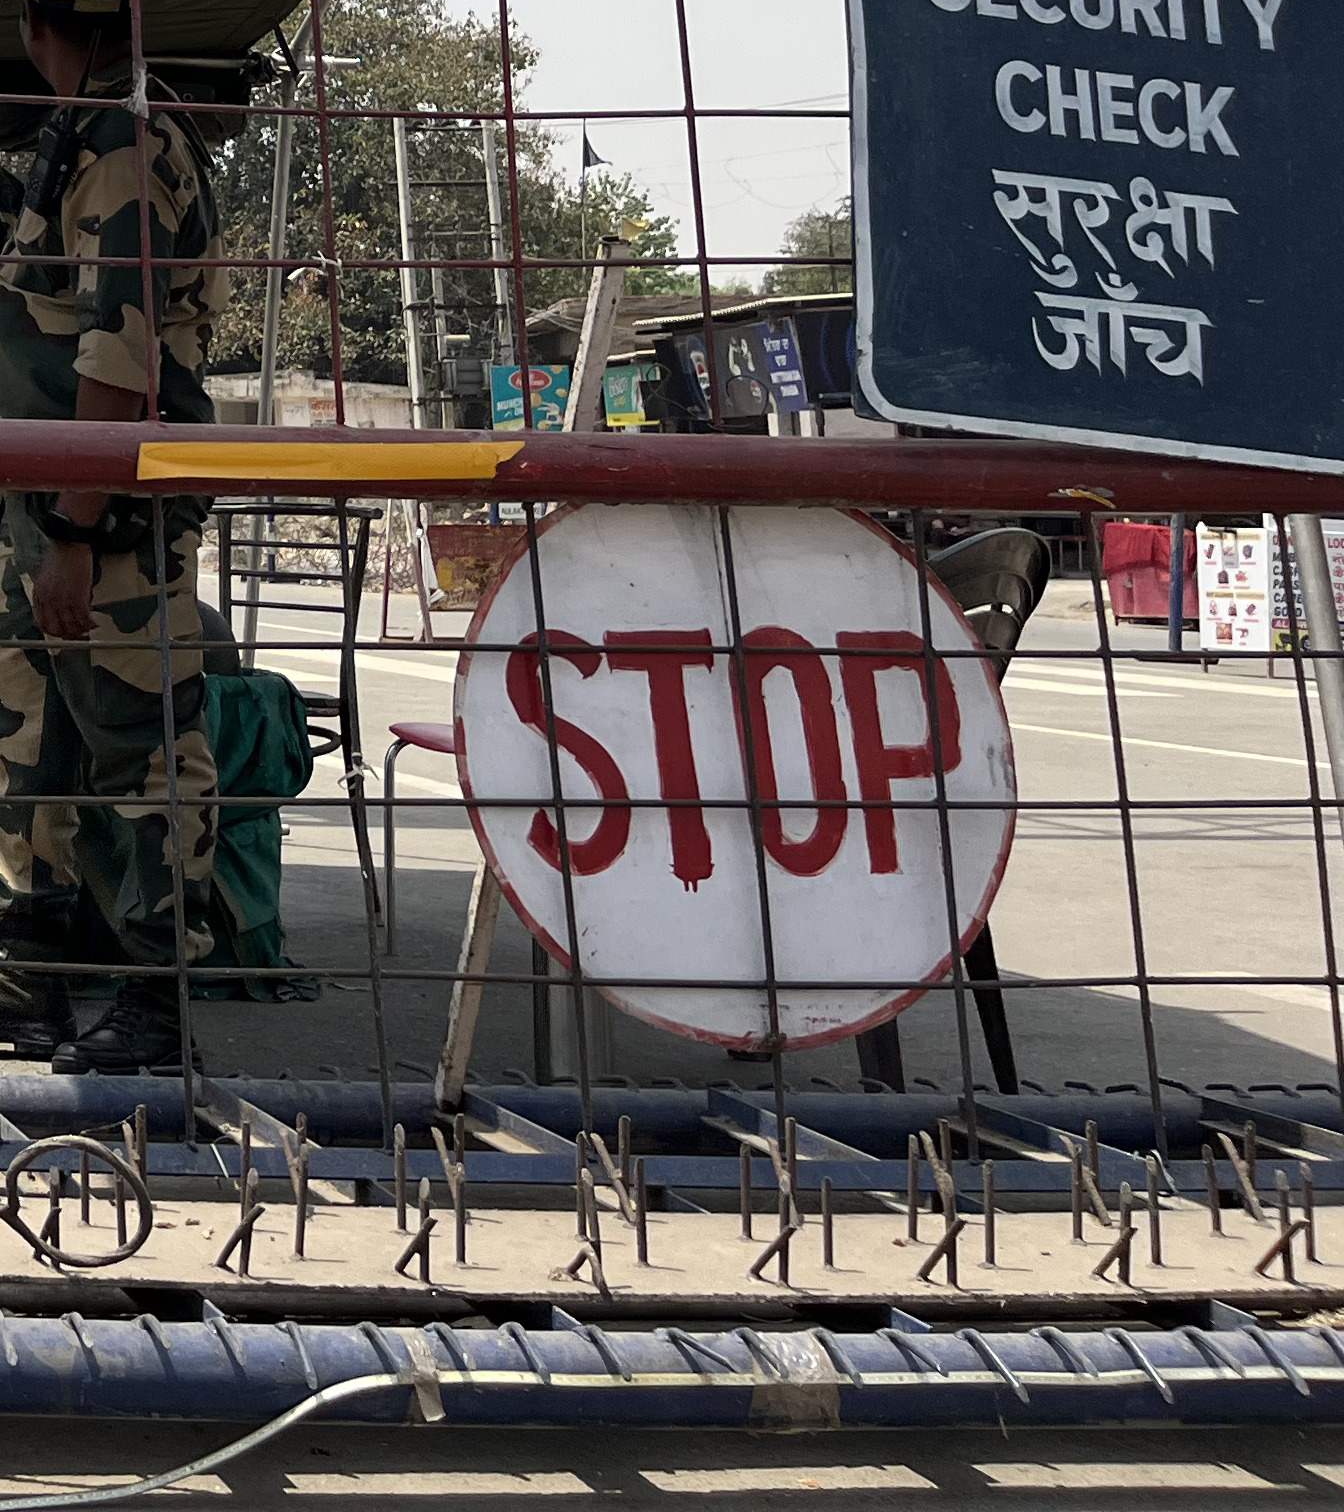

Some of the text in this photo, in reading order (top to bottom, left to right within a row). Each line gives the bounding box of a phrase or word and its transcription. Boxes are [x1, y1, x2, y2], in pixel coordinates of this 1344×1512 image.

[995, 59, 1240, 157] CHECK
[991, 168, 1239, 288] सुरक्षा
[1031, 271, 1214, 388] जाँच
[505, 624, 962, 888] STOP
